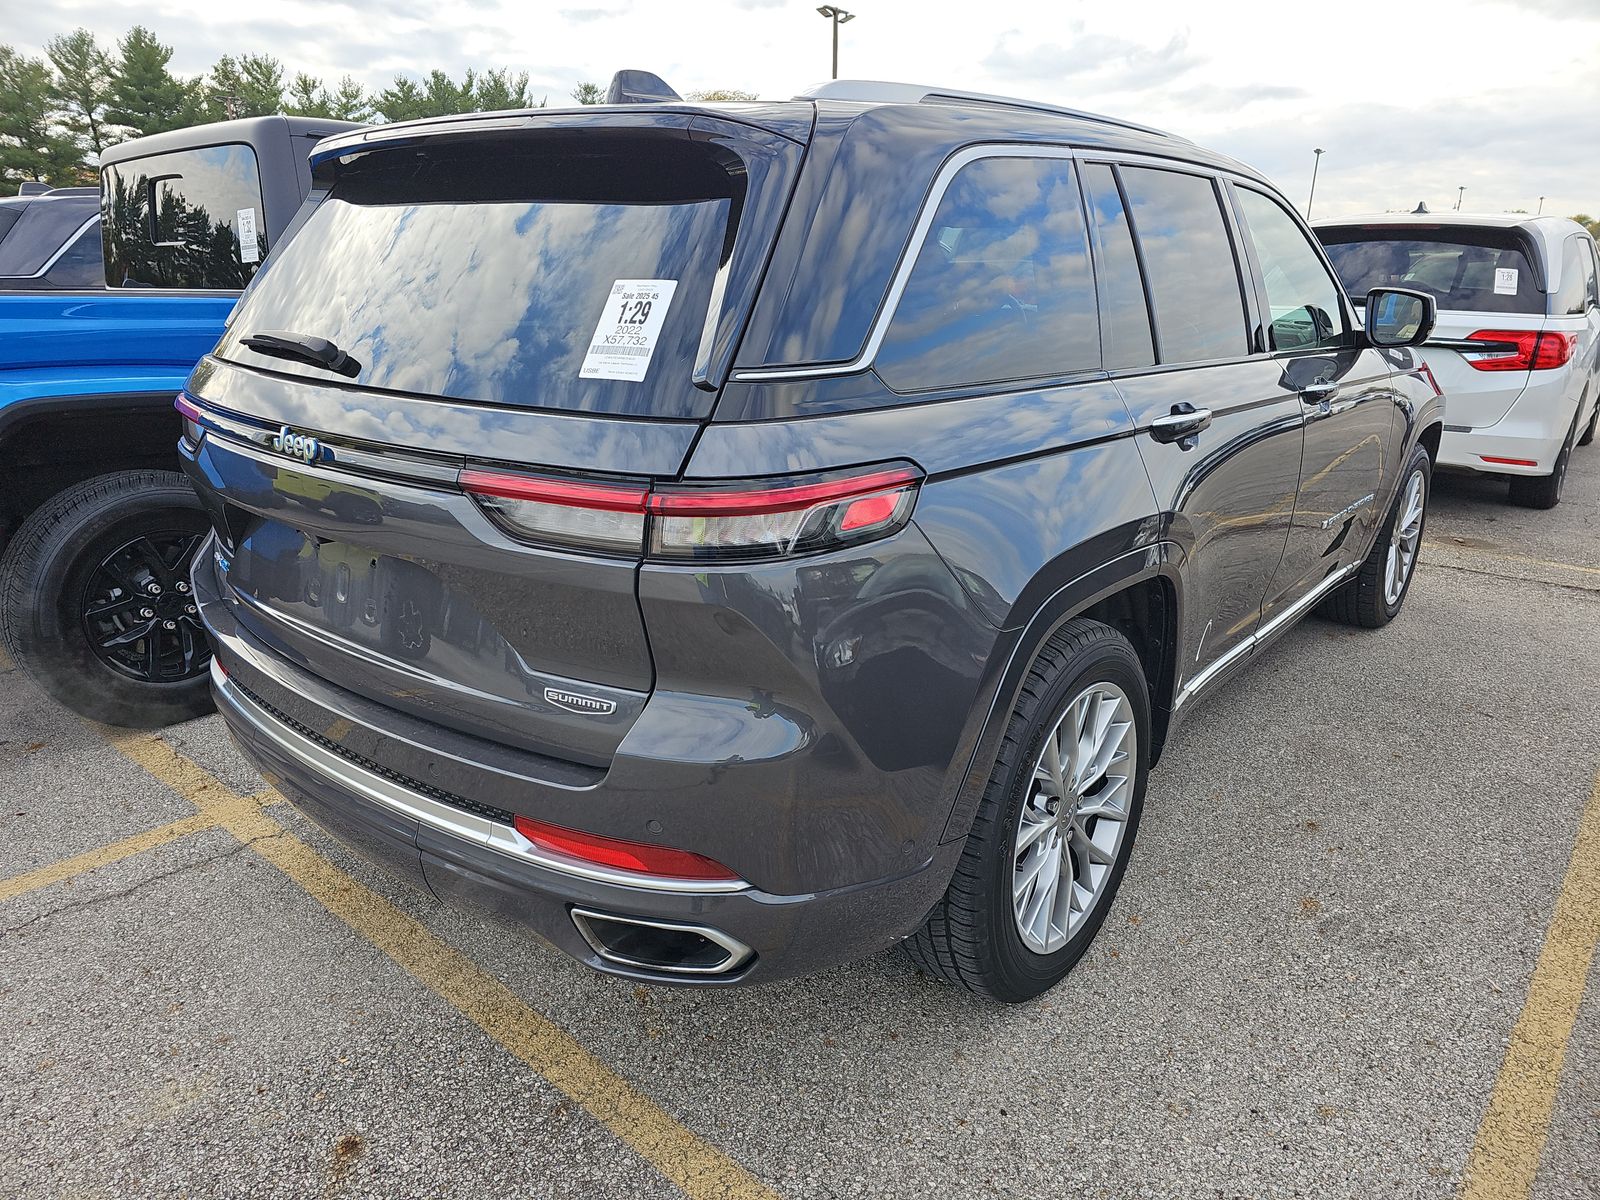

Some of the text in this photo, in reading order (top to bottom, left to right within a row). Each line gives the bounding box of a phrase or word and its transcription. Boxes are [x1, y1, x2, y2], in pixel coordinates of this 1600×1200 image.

[621, 292, 660, 300] Sale 2025 45
[617, 300, 652, 325] 1:29
[615, 325, 643, 335] 2022
[273, 425, 319, 465] Jeep
[547, 691, 611, 710] SUMMIT
